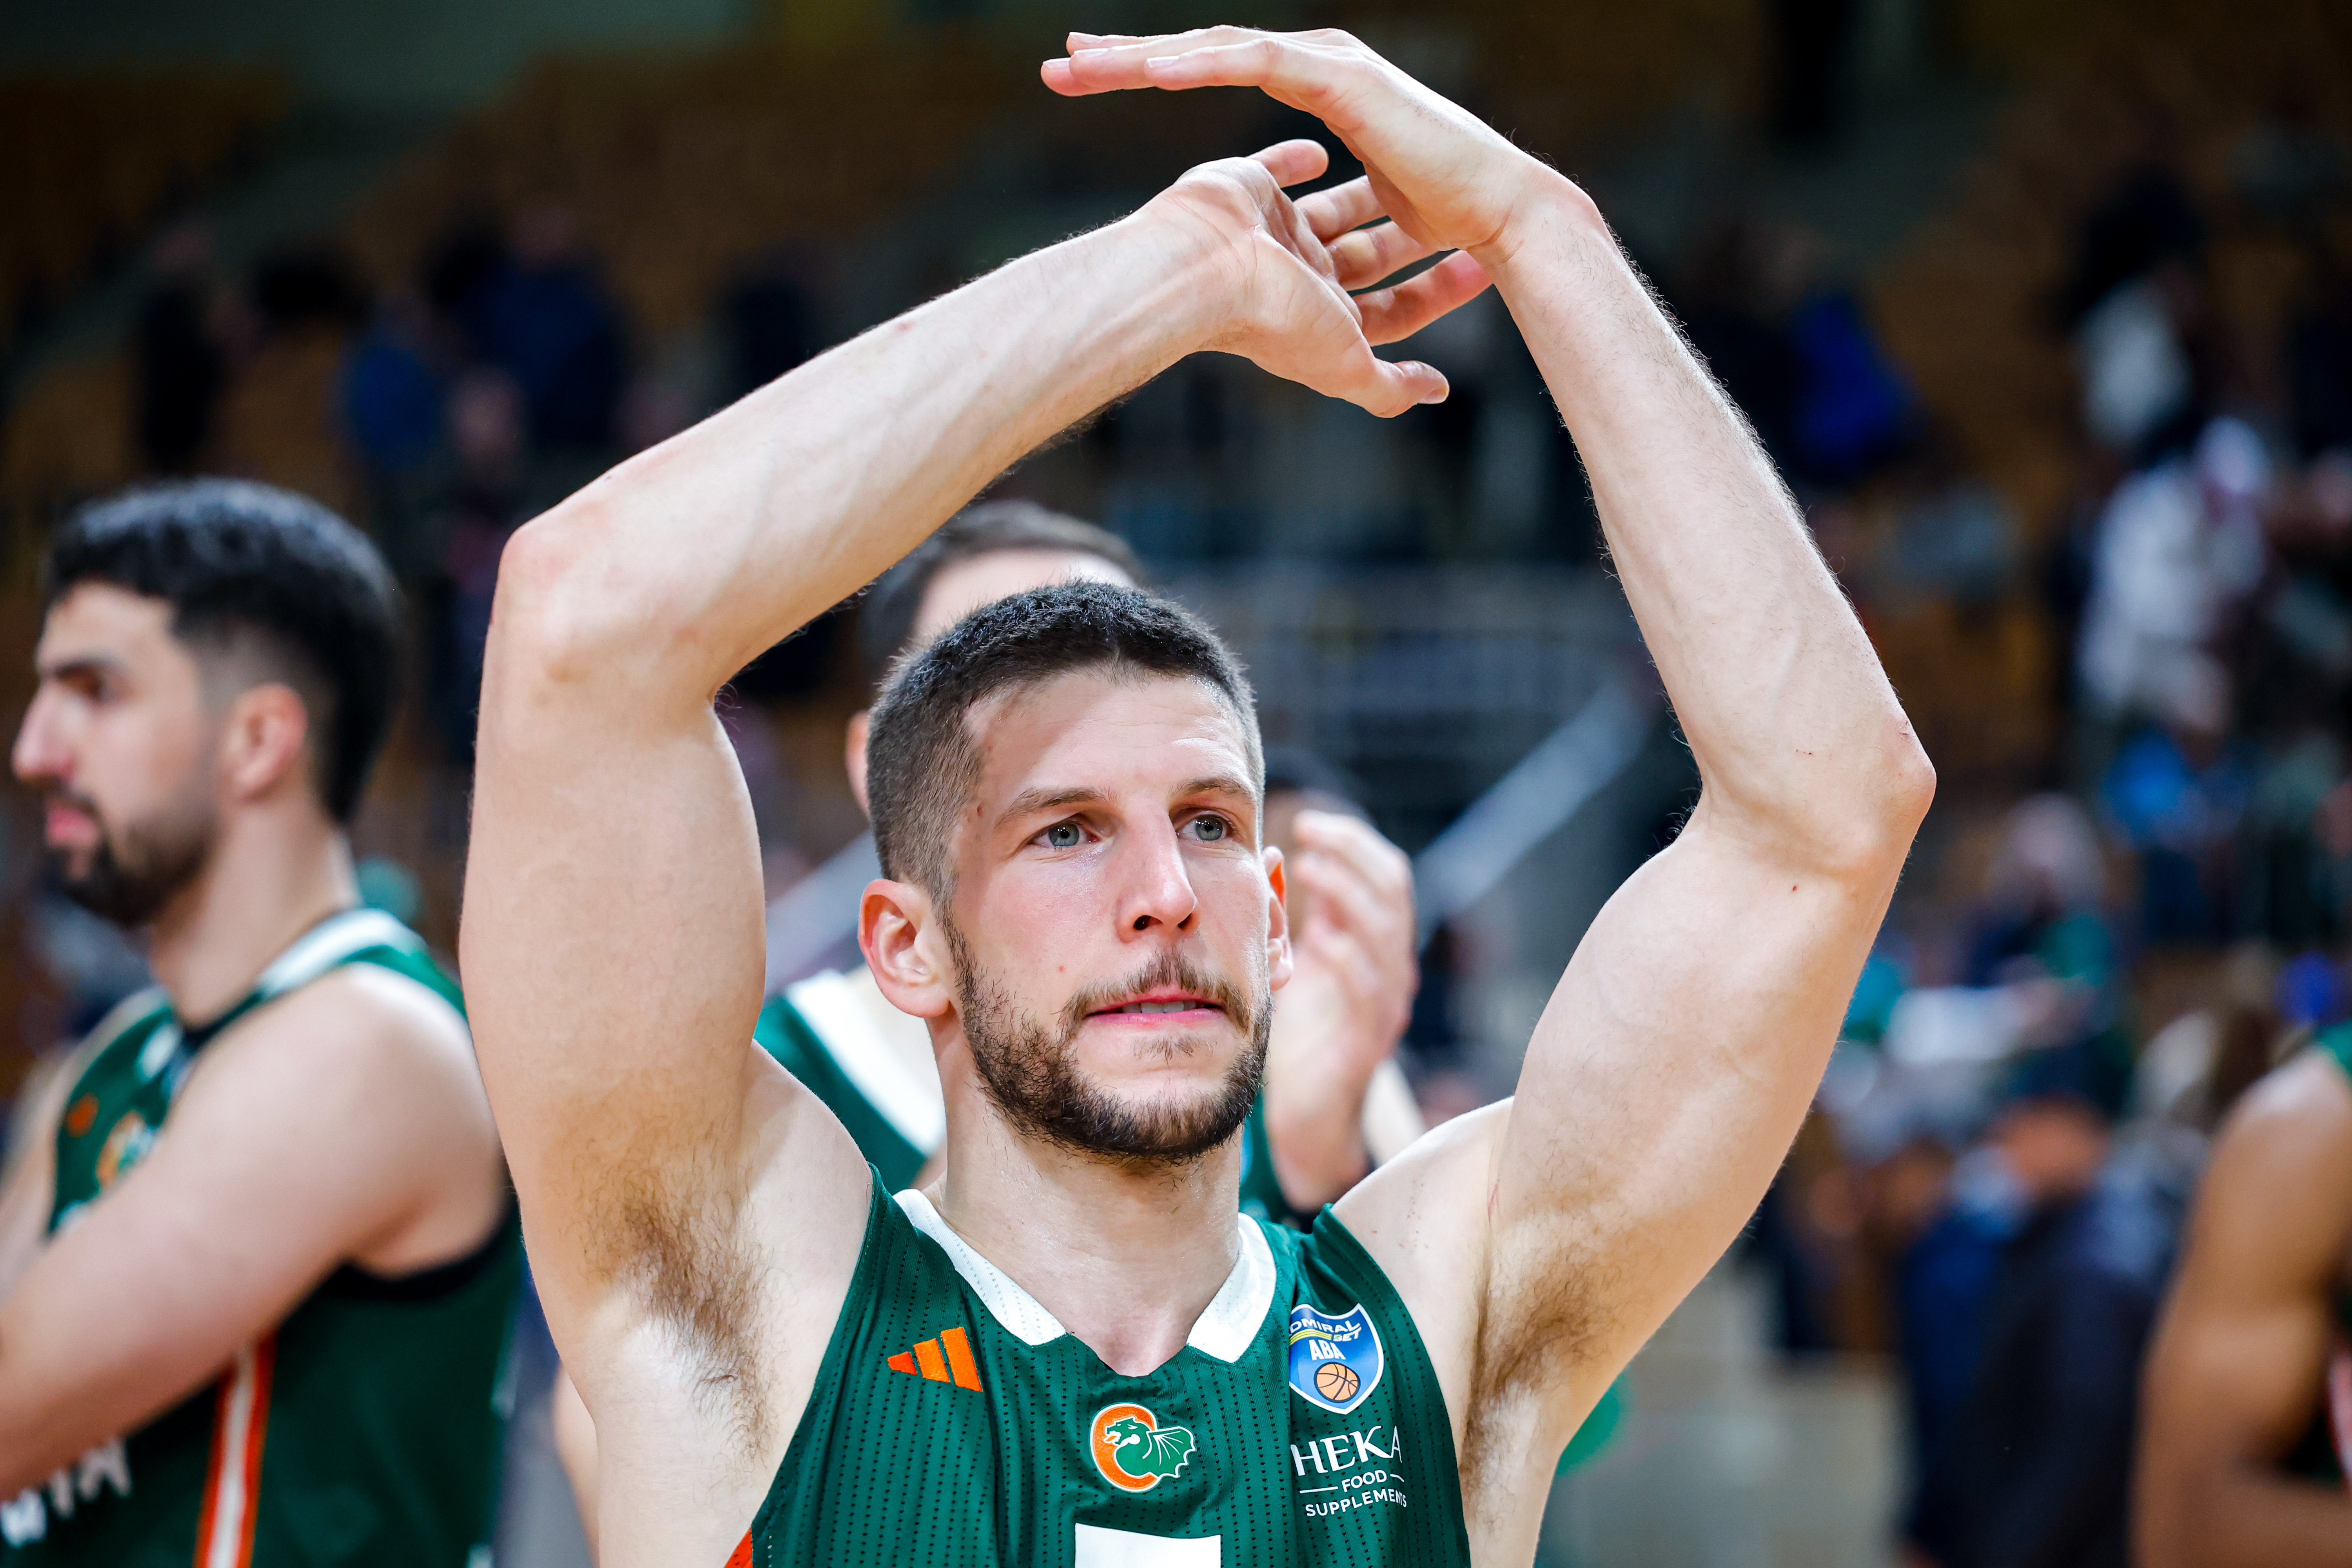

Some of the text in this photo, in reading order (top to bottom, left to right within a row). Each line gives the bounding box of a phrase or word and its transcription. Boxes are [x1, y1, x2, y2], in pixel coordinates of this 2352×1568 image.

[1289, 1318, 1361, 1335] DMIRAL
[1333, 1327, 1362, 1342] BET
[1308, 1339, 1347, 1361] ABA
[1290, 1425, 1403, 1476] HEKA
[1341, 1470, 1387, 1493] FOOD
[1305, 1488, 1407, 1517] SUPPLEMENTS
